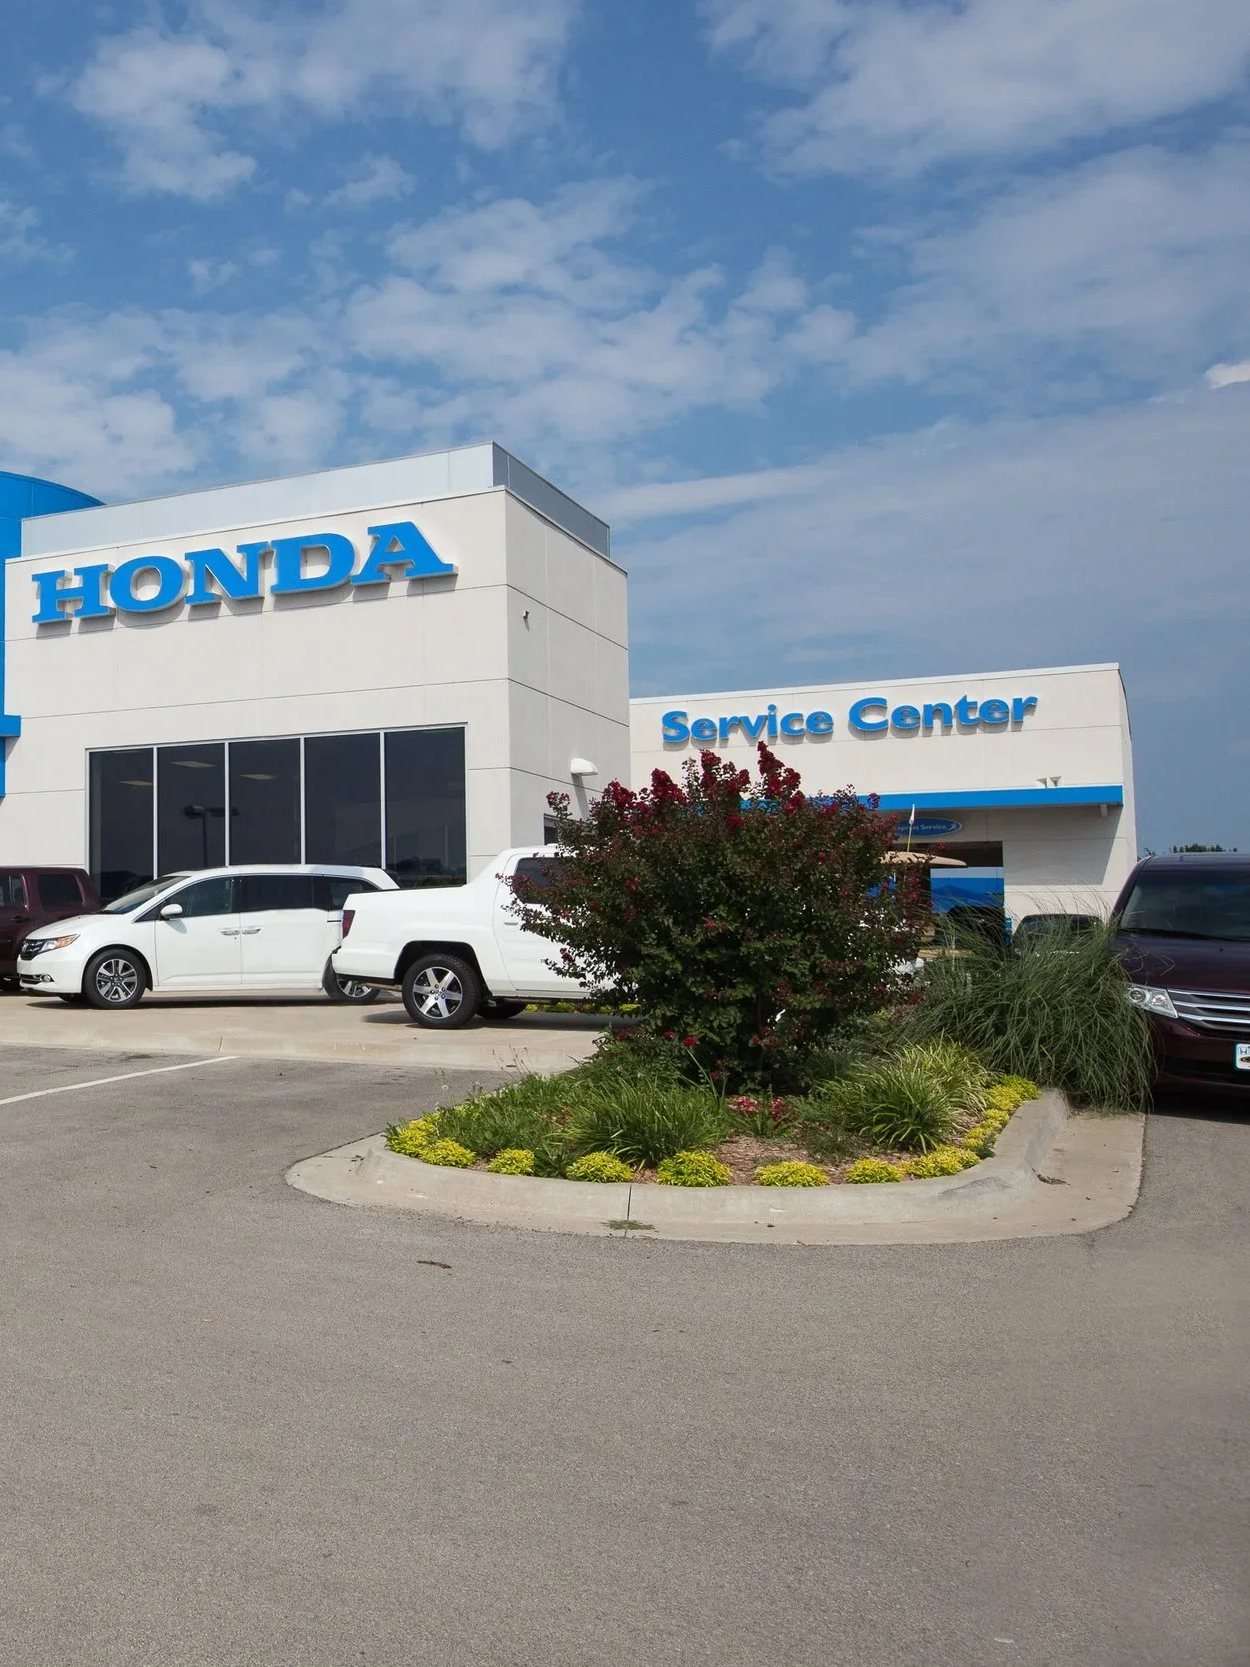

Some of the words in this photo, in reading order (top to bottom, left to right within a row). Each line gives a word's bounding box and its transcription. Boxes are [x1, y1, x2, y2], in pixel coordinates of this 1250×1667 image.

[31, 520, 459, 624] HONDA
[661, 703, 834, 743] Service
[849, 694, 1039, 732] Center
